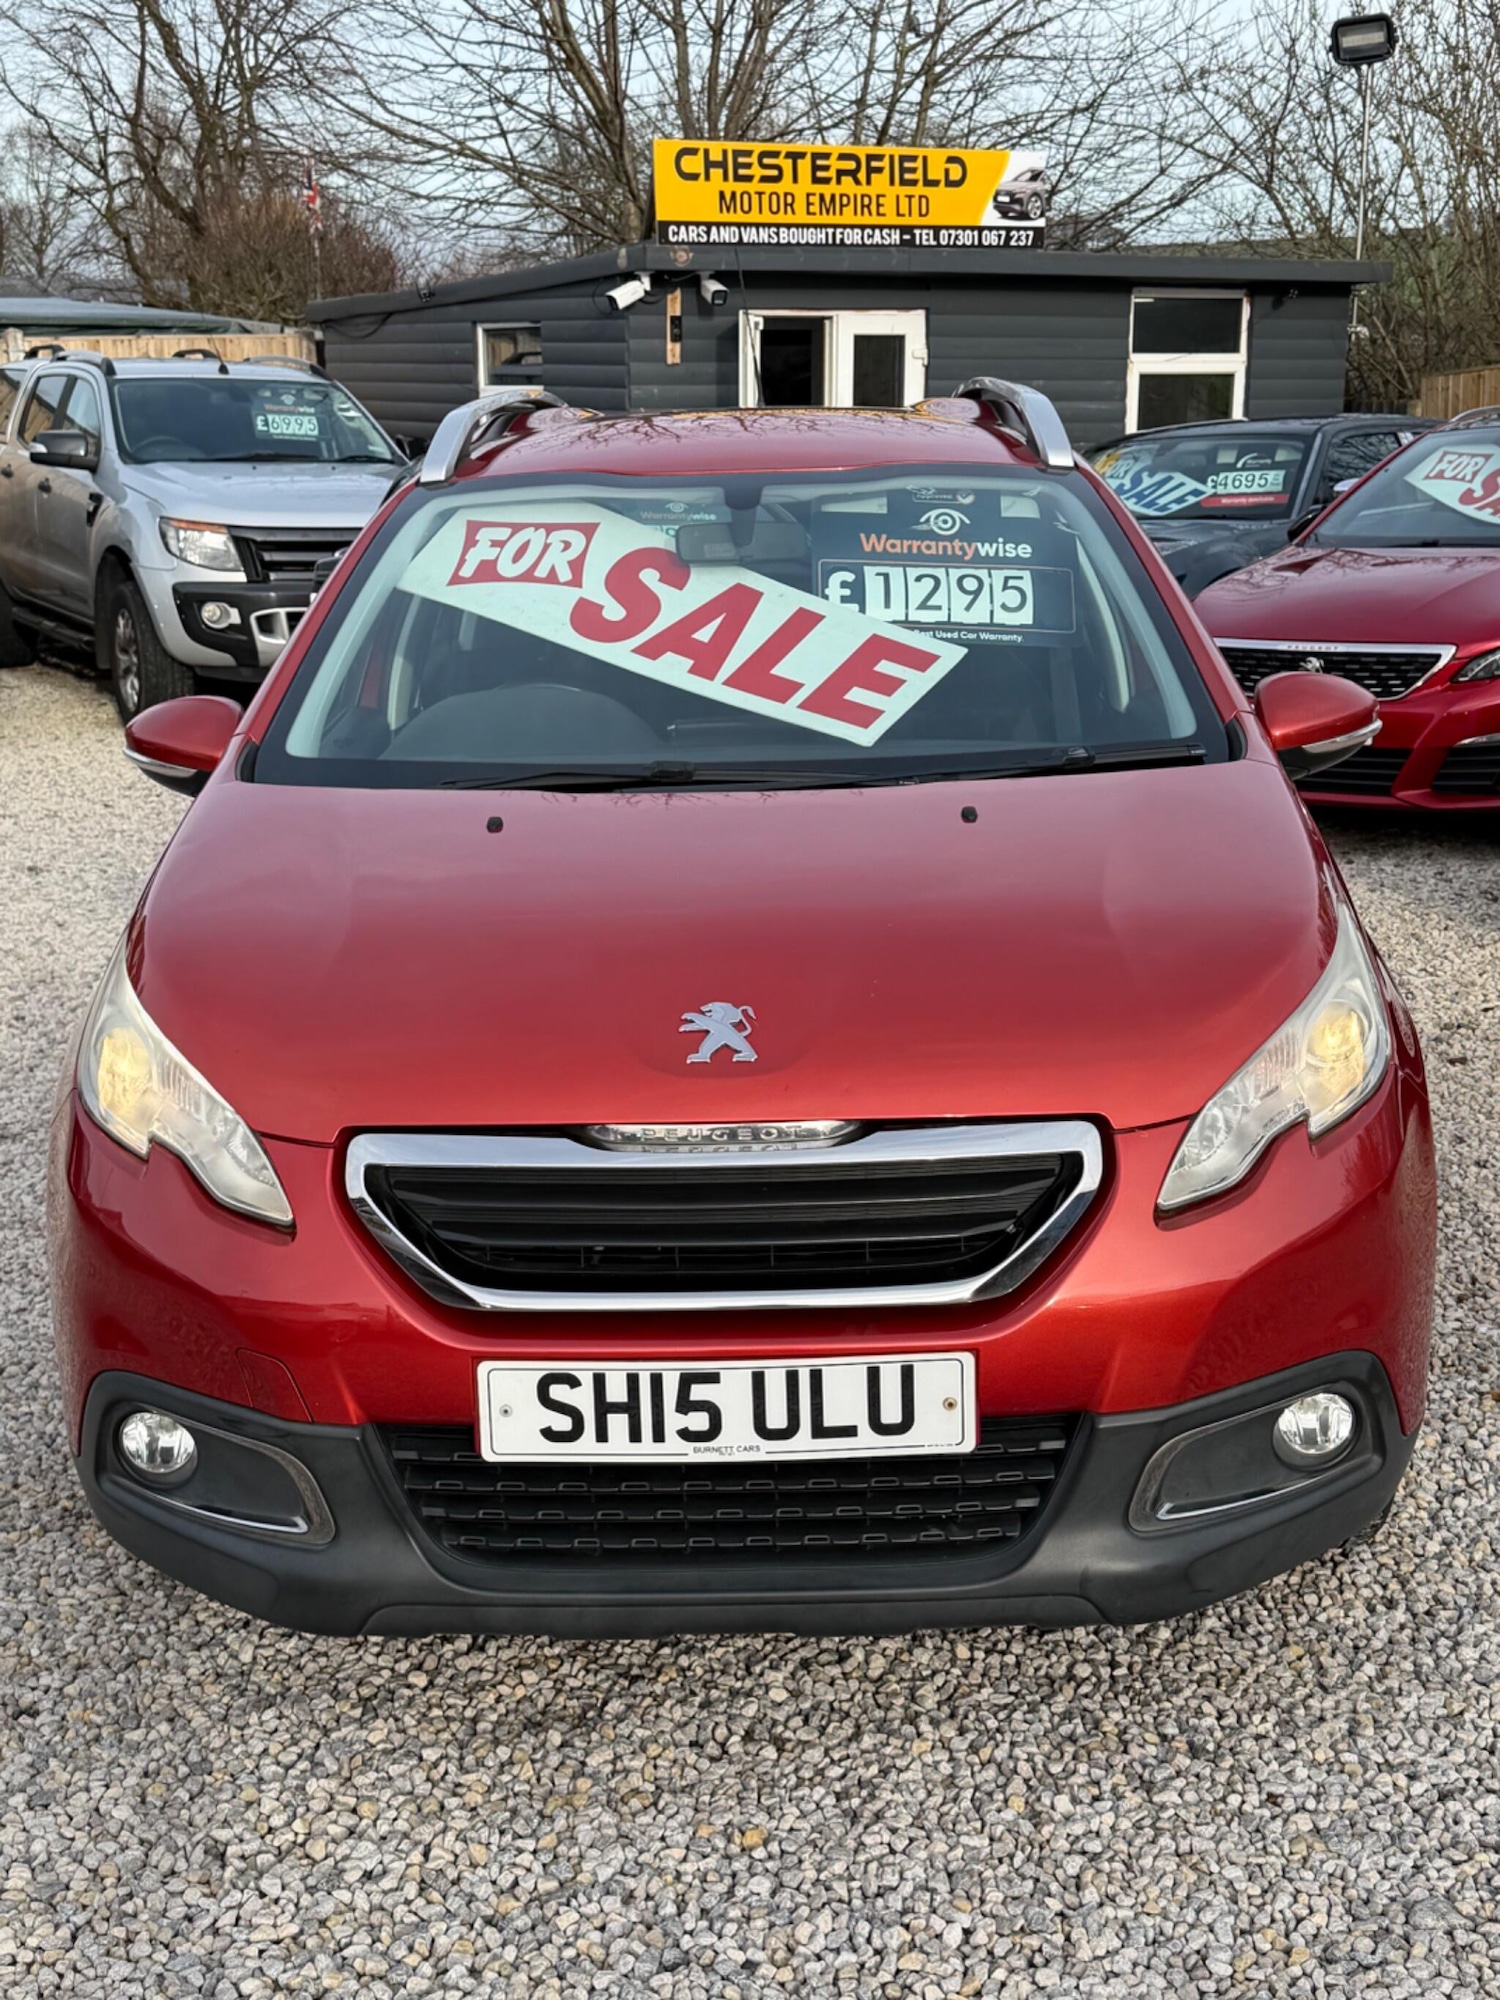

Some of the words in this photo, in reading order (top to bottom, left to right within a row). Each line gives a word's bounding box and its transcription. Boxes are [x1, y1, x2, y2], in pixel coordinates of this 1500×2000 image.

[674, 147, 967, 188] CHESTERFIELD
[718, 190, 796, 215] MOTOR
[806, 192, 887, 216] EMPIRE
[896, 194, 930, 217] LTD
[668, 225, 708, 243] CARS
[709, 226, 739, 244] AND
[740, 227, 778, 244] VANS
[779, 228, 835, 245] BOUGHT
[836, 228, 863, 245] FOR
[865, 229, 900, 246] CASH
[914, 229, 938, 246] TEL
[939, 230, 979, 246] 07301
[981, 230, 1007, 247] 067
[1009, 231, 1034, 247] 237
[256, 415, 318, 433] £6995
[1428, 453, 1487, 482] FOR
[1115, 463, 1207, 513] SALE
[1207, 473, 1270, 491] £4695
[640, 511, 717, 521] Warrantywise
[458, 524, 588, 584] FOR
[859, 533, 1033, 560] Warrantywise
[824, 570, 1029, 614] £1295
[570, 546, 942, 730] SALE
[935, 630, 958, 639] Used
[960, 631, 977, 639] Car
[640, 1125, 802, 1142] PEUGEOT
[536, 1371, 723, 1443] SH15
[751, 1363, 916, 1441] ULU
